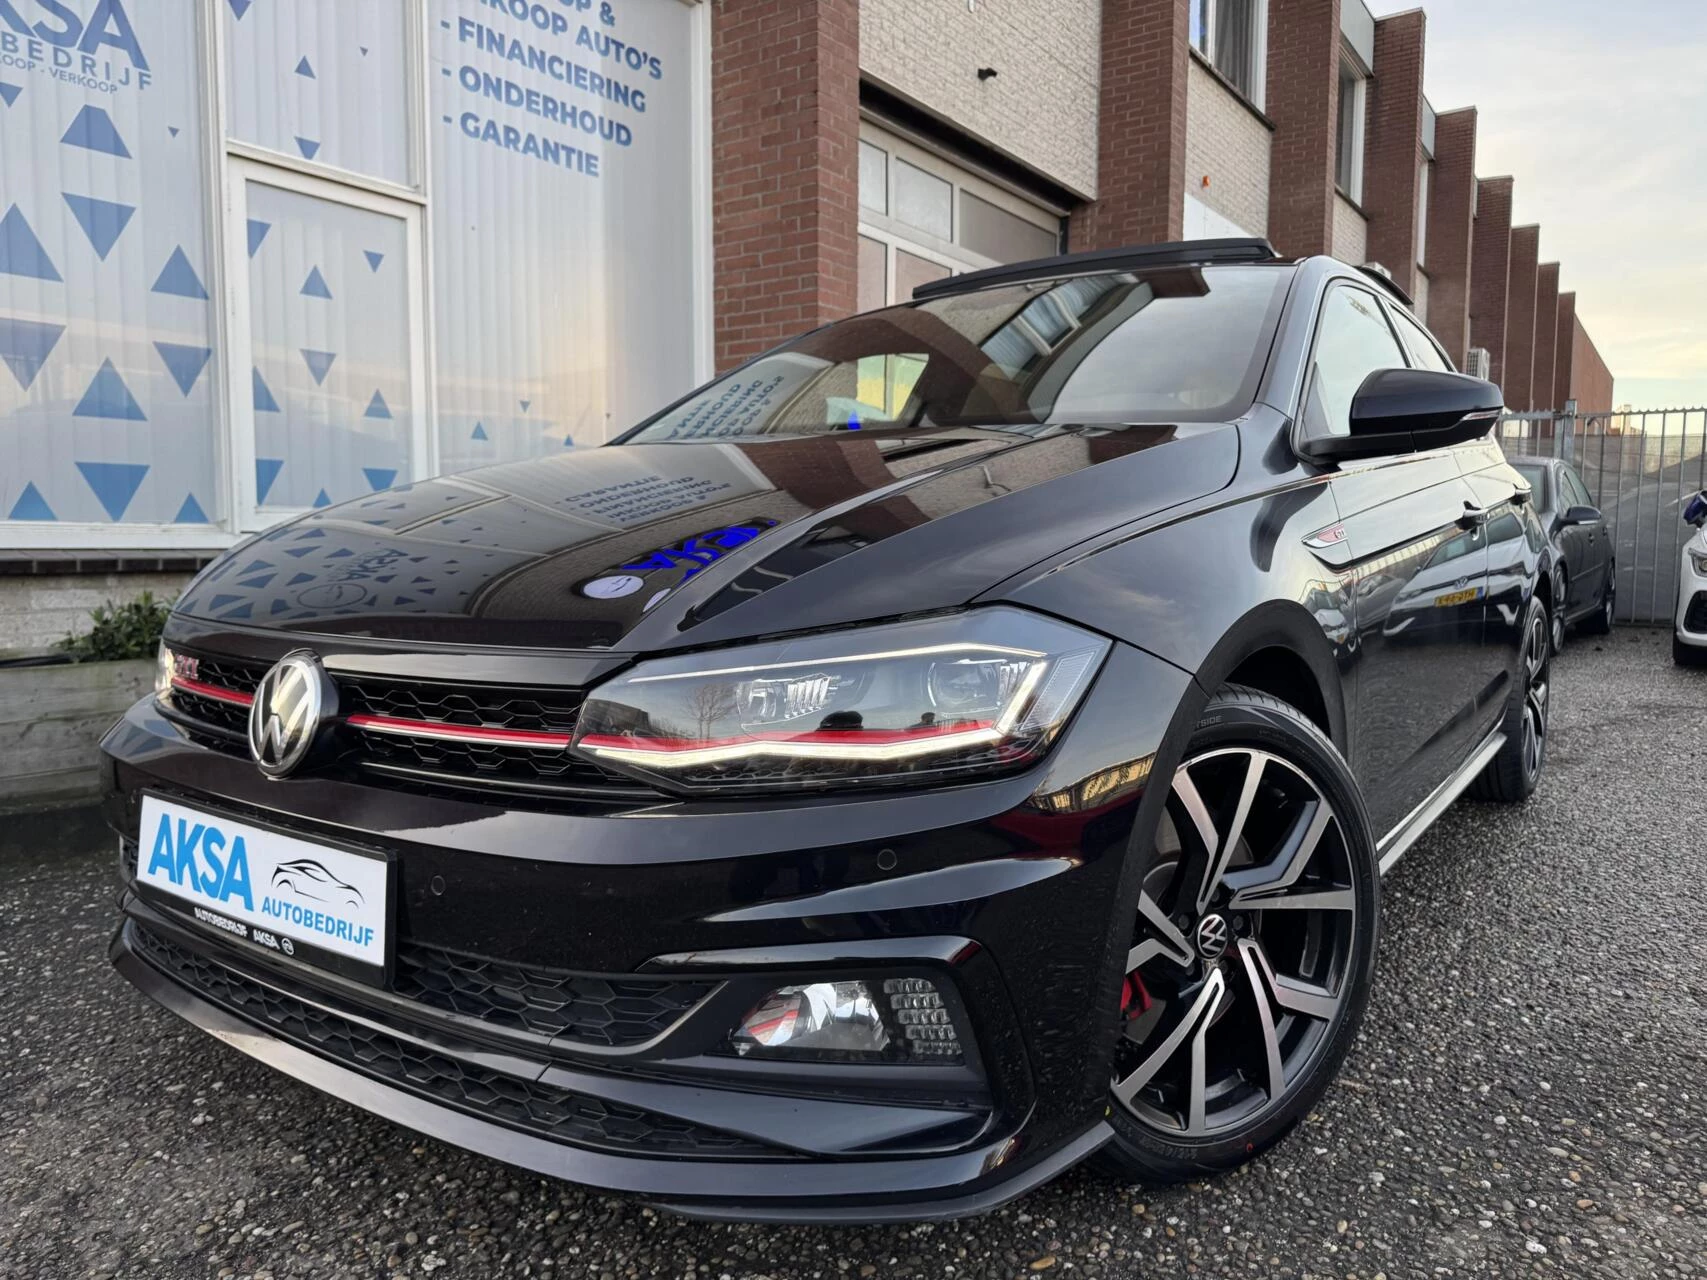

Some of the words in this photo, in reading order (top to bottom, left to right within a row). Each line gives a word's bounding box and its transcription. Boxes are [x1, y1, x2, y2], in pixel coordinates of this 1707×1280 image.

[0, 54, 36, 71] OOP
[49, 67, 118, 94] VERKOOP
[458, 16, 646, 113] FINANCIERING
[480, 0, 568, 36] OOP
[575, 25, 662, 80] AUTO'S
[459, 65, 632, 147] ONDERHOUD
[460, 111, 599, 177] GARANTIE
[147, 813, 254, 912] AKSA
[253, 928, 280, 950] AKSA
[261, 896, 374, 946] AUTOBEDRIJF
